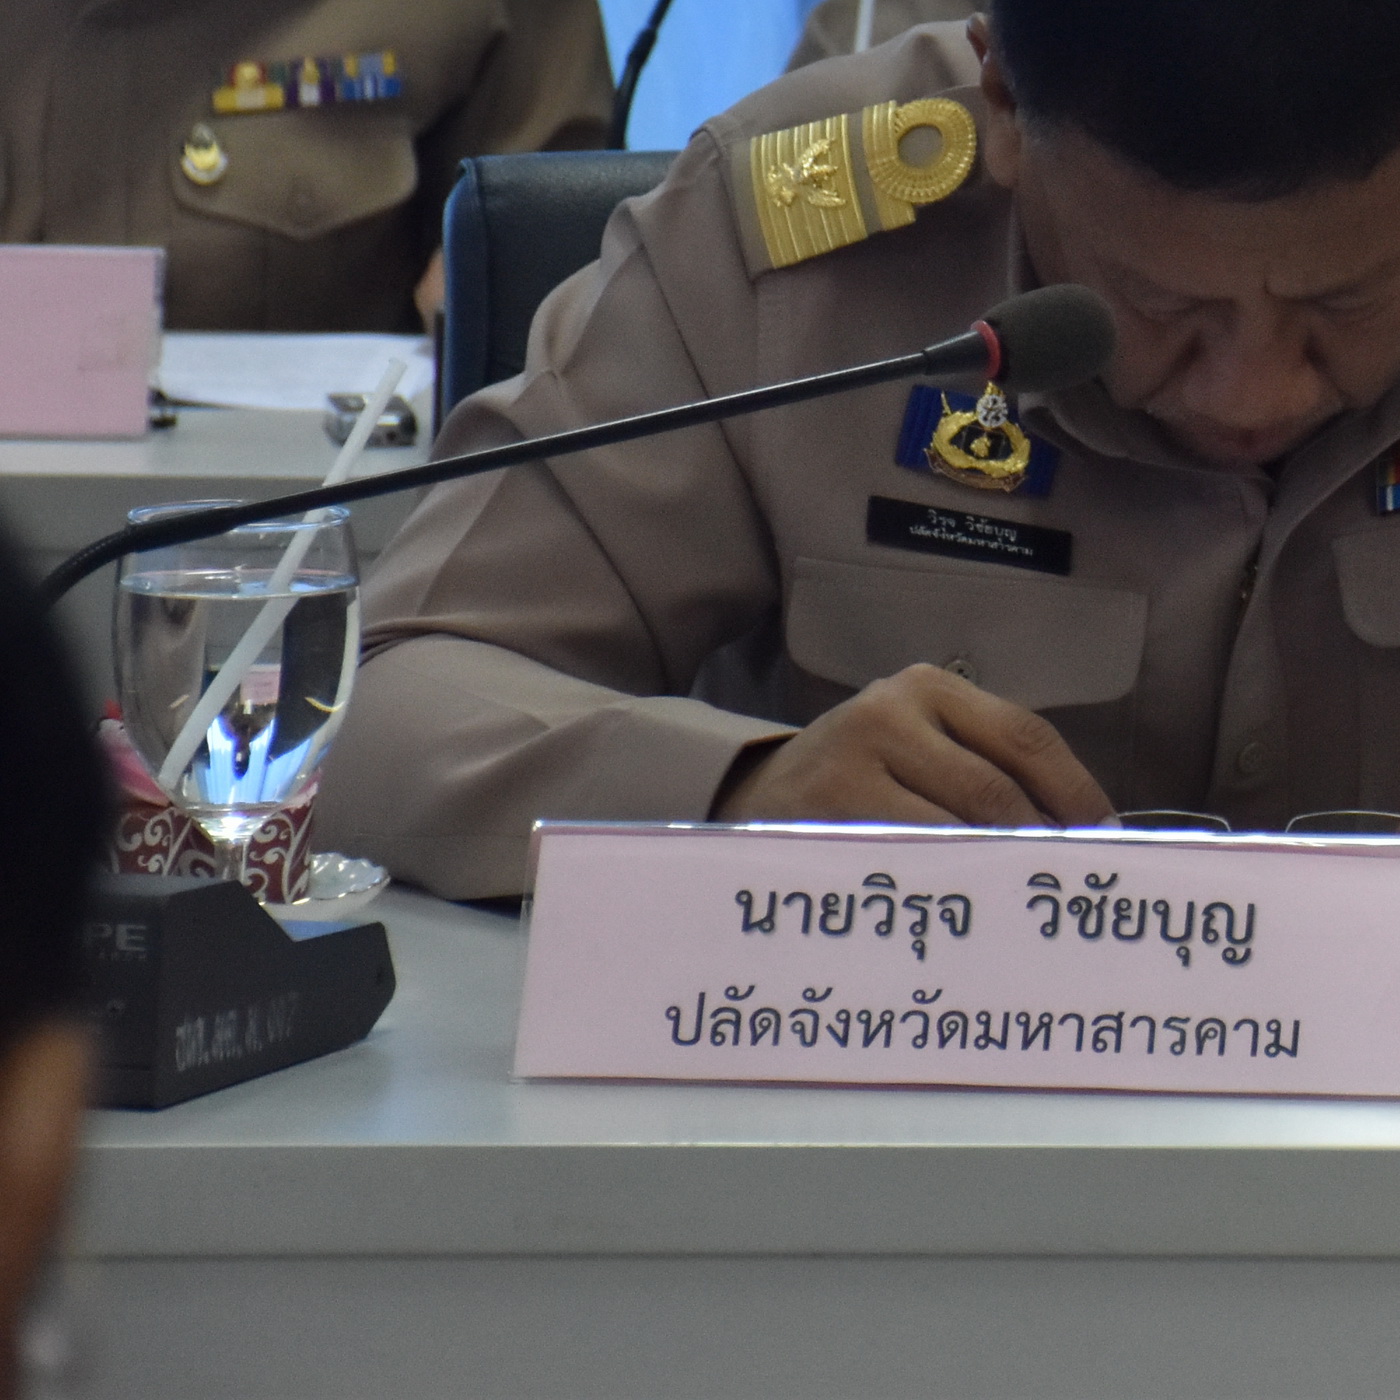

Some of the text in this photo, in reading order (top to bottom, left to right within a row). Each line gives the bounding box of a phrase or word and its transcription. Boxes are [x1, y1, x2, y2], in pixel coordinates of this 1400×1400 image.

[735, 872, 1257, 968] นายวิรุจ วิชัยบุญ
[664, 986, 1301, 1059] ปลัดจังหวัดมหาสารคาม
